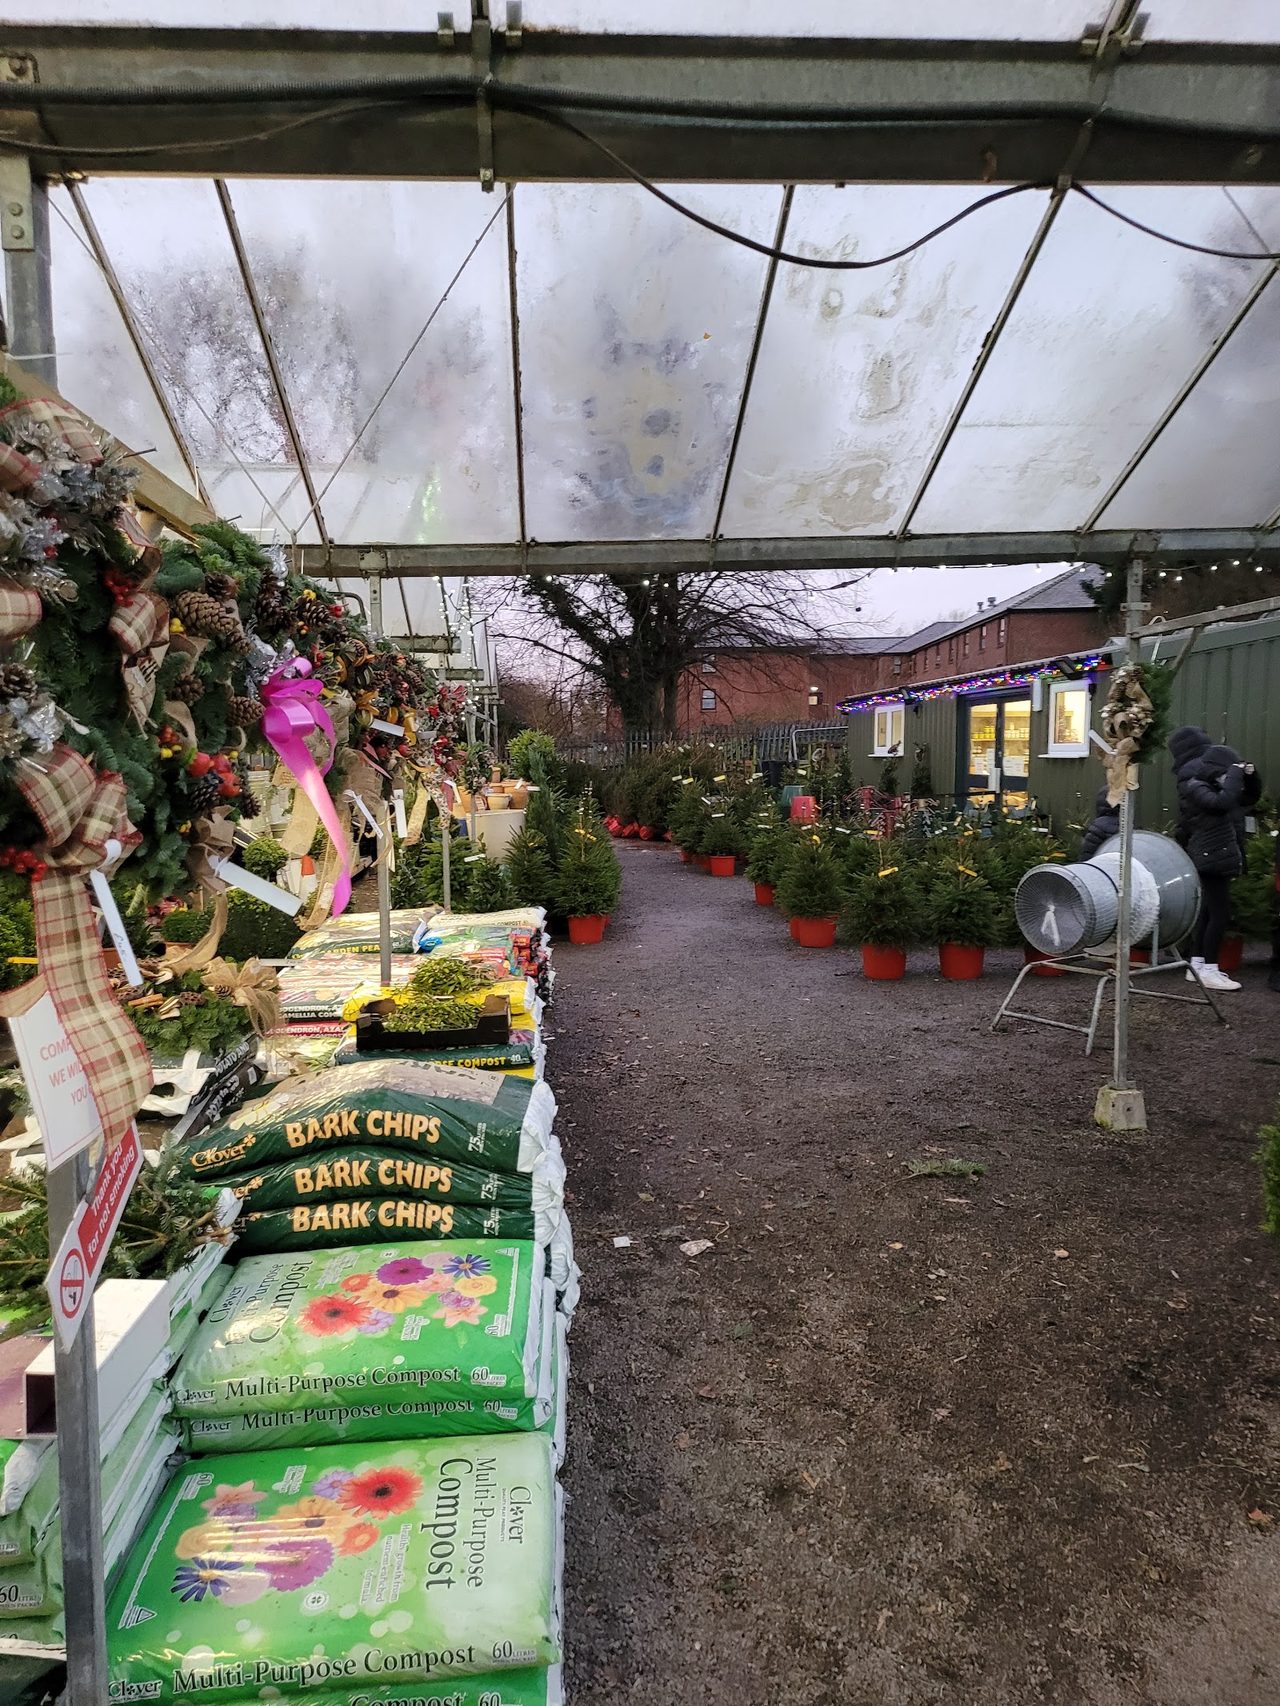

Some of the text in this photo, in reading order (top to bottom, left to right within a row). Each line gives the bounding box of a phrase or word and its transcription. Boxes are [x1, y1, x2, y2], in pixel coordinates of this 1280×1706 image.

[362, 944, 381, 953] PEA
[49, 1069, 66, 1087] WE
[457, 1056, 506, 1068] COMPOST
[285, 1109, 360, 1148] BARK
[366, 1110, 442, 1144] CHIPS
[468, 1136, 479, 1152] 75
[191, 1144, 247, 1167] Clover
[92, 1143, 123, 1216] Thank you
[294, 1159, 371, 1194] BARK
[378, 1159, 453, 1193] CHIPS
[481, 1184, 493, 1199] 75
[88, 1144, 135, 1258] for not smoking
[292, 1201, 371, 1232] BARK
[378, 1201, 454, 1233] CHIPS
[483, 1220, 495, 1235] 75
[225, 1372, 368, 1400] Multi-Purpose
[371, 1367, 460, 1387] Compost
[472, 1367, 489, 1381] 60
[191, 1420, 231, 1432] Clover
[242, 1403, 381, 1430] Multi-Purpose
[421, 1458, 473, 1590] Compost
[462, 1457, 497, 1588] Multi-Purpose
[509, 1486, 532, 1544] Clover
[109, 1681, 161, 1697] Clover
[173, 1659, 357, 1694] Multi-Purpose
[364, 1645, 476, 1673] Compost
[493, 1640, 512, 1658] 60
